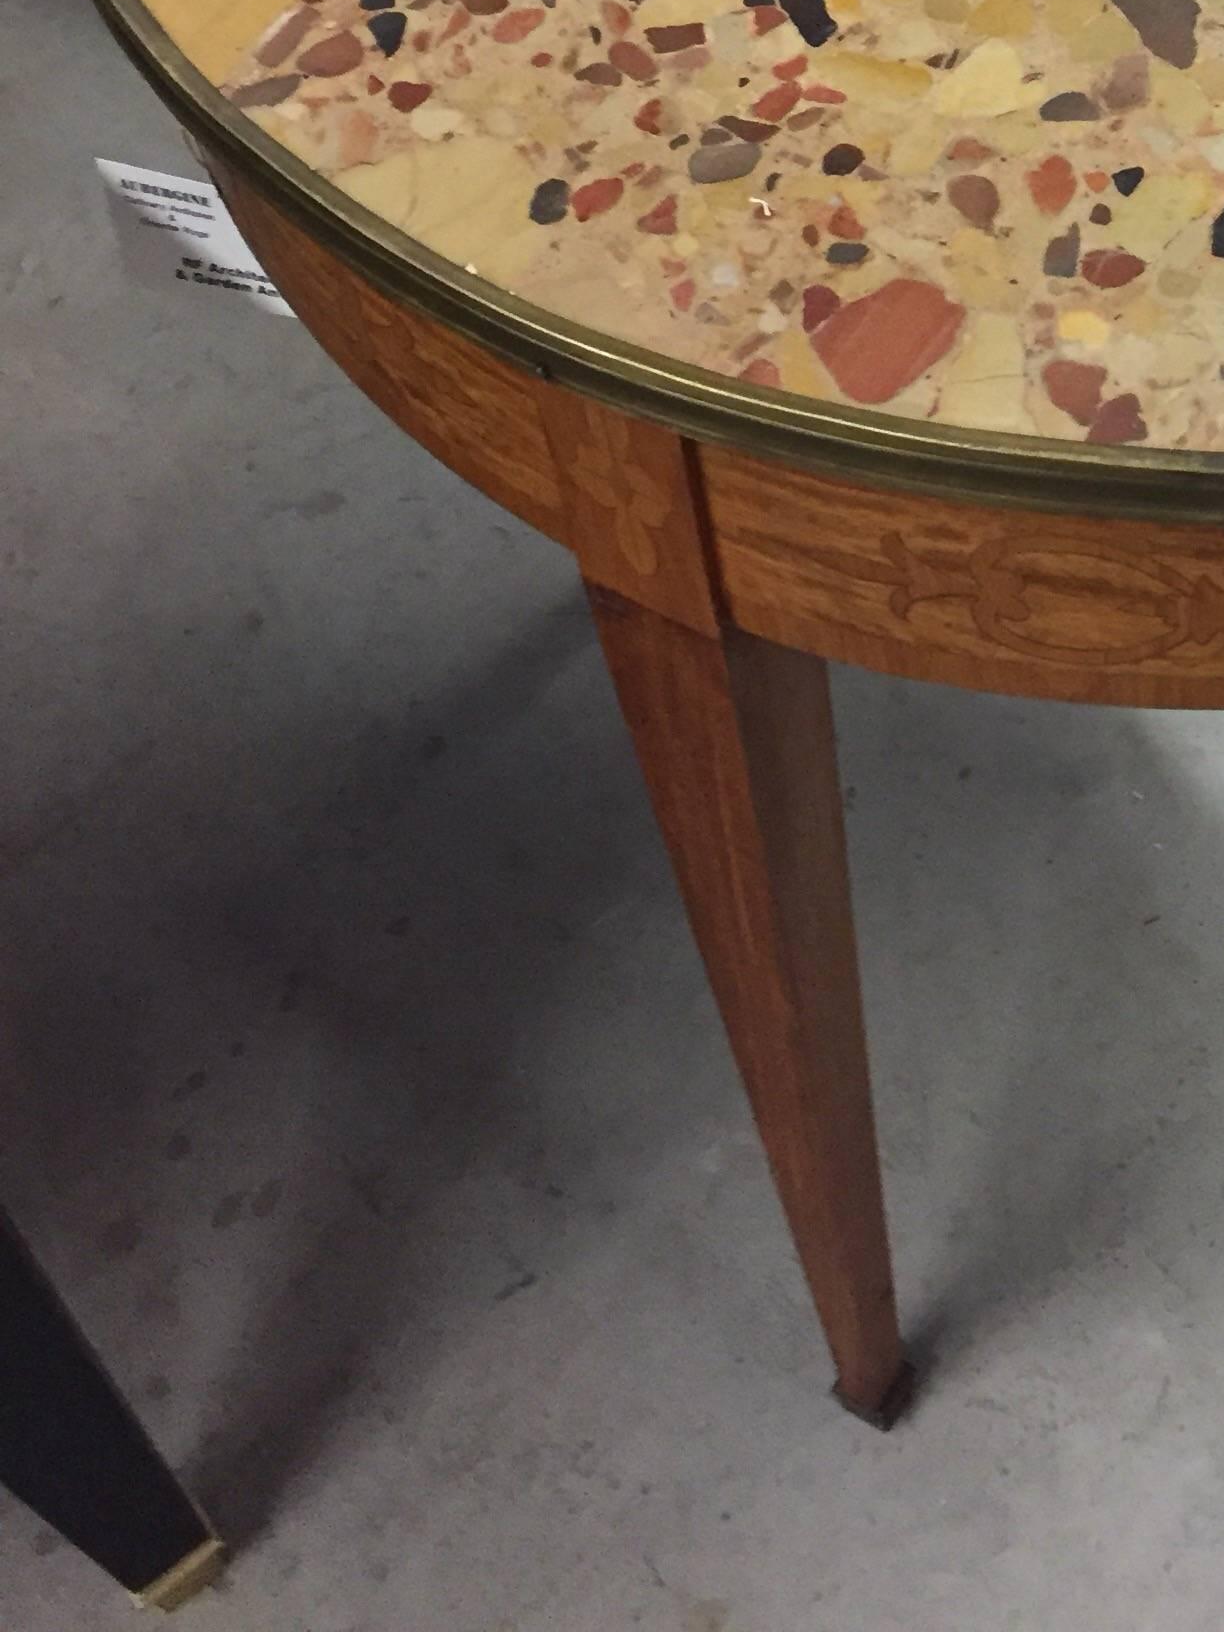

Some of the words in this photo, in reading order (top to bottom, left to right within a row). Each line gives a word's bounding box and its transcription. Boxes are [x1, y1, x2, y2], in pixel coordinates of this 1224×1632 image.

[120, 179, 210, 207] AUBERGINE
[175, 269, 188, 281] &
[193, 272, 252, 292] Garden
